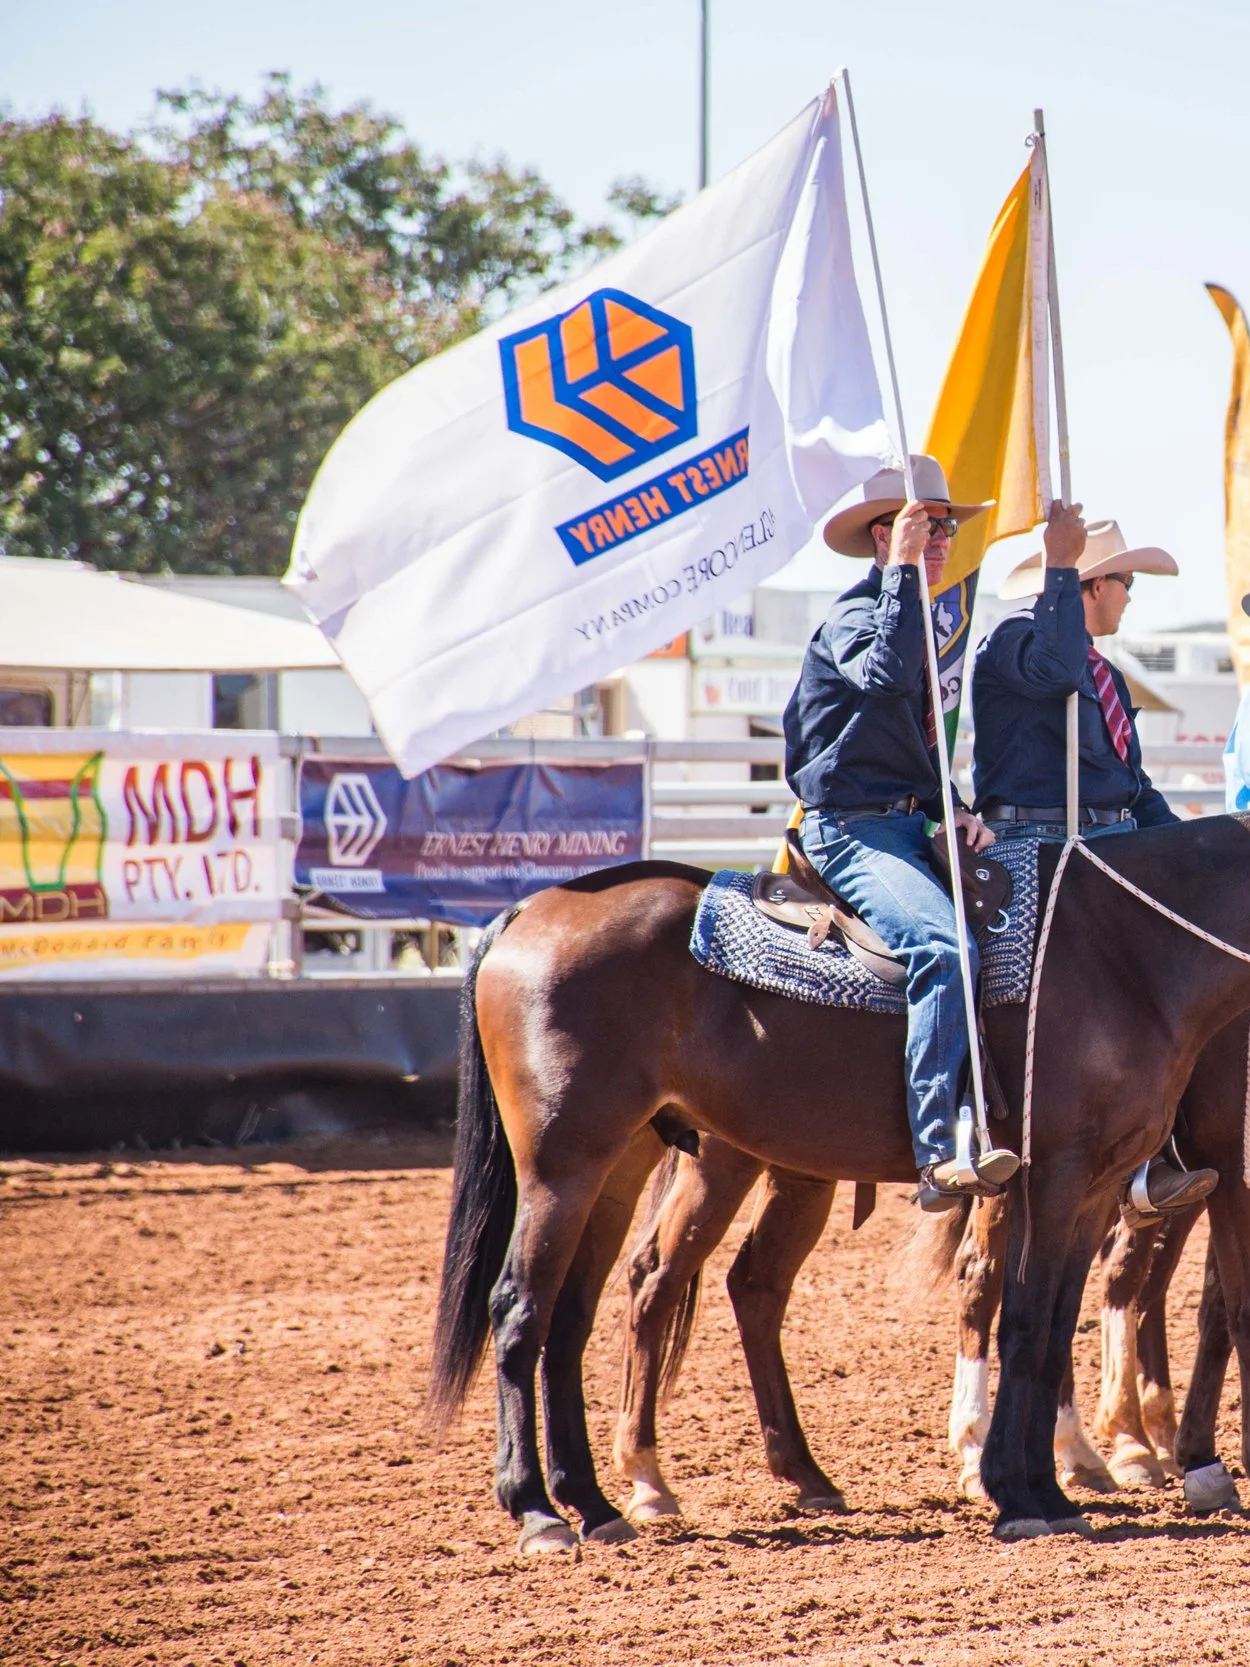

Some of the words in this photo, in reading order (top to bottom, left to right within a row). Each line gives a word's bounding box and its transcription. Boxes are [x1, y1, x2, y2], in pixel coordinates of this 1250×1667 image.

[123, 756, 261, 847] MDH
[421, 831, 492, 857] ERNEST
[489, 831, 555, 857] HENRY
[554, 830, 628, 857] MINING
[123, 856, 194, 905] PTY.
[462, 866, 501, 886] support
[0, 888, 106, 921] MDH
